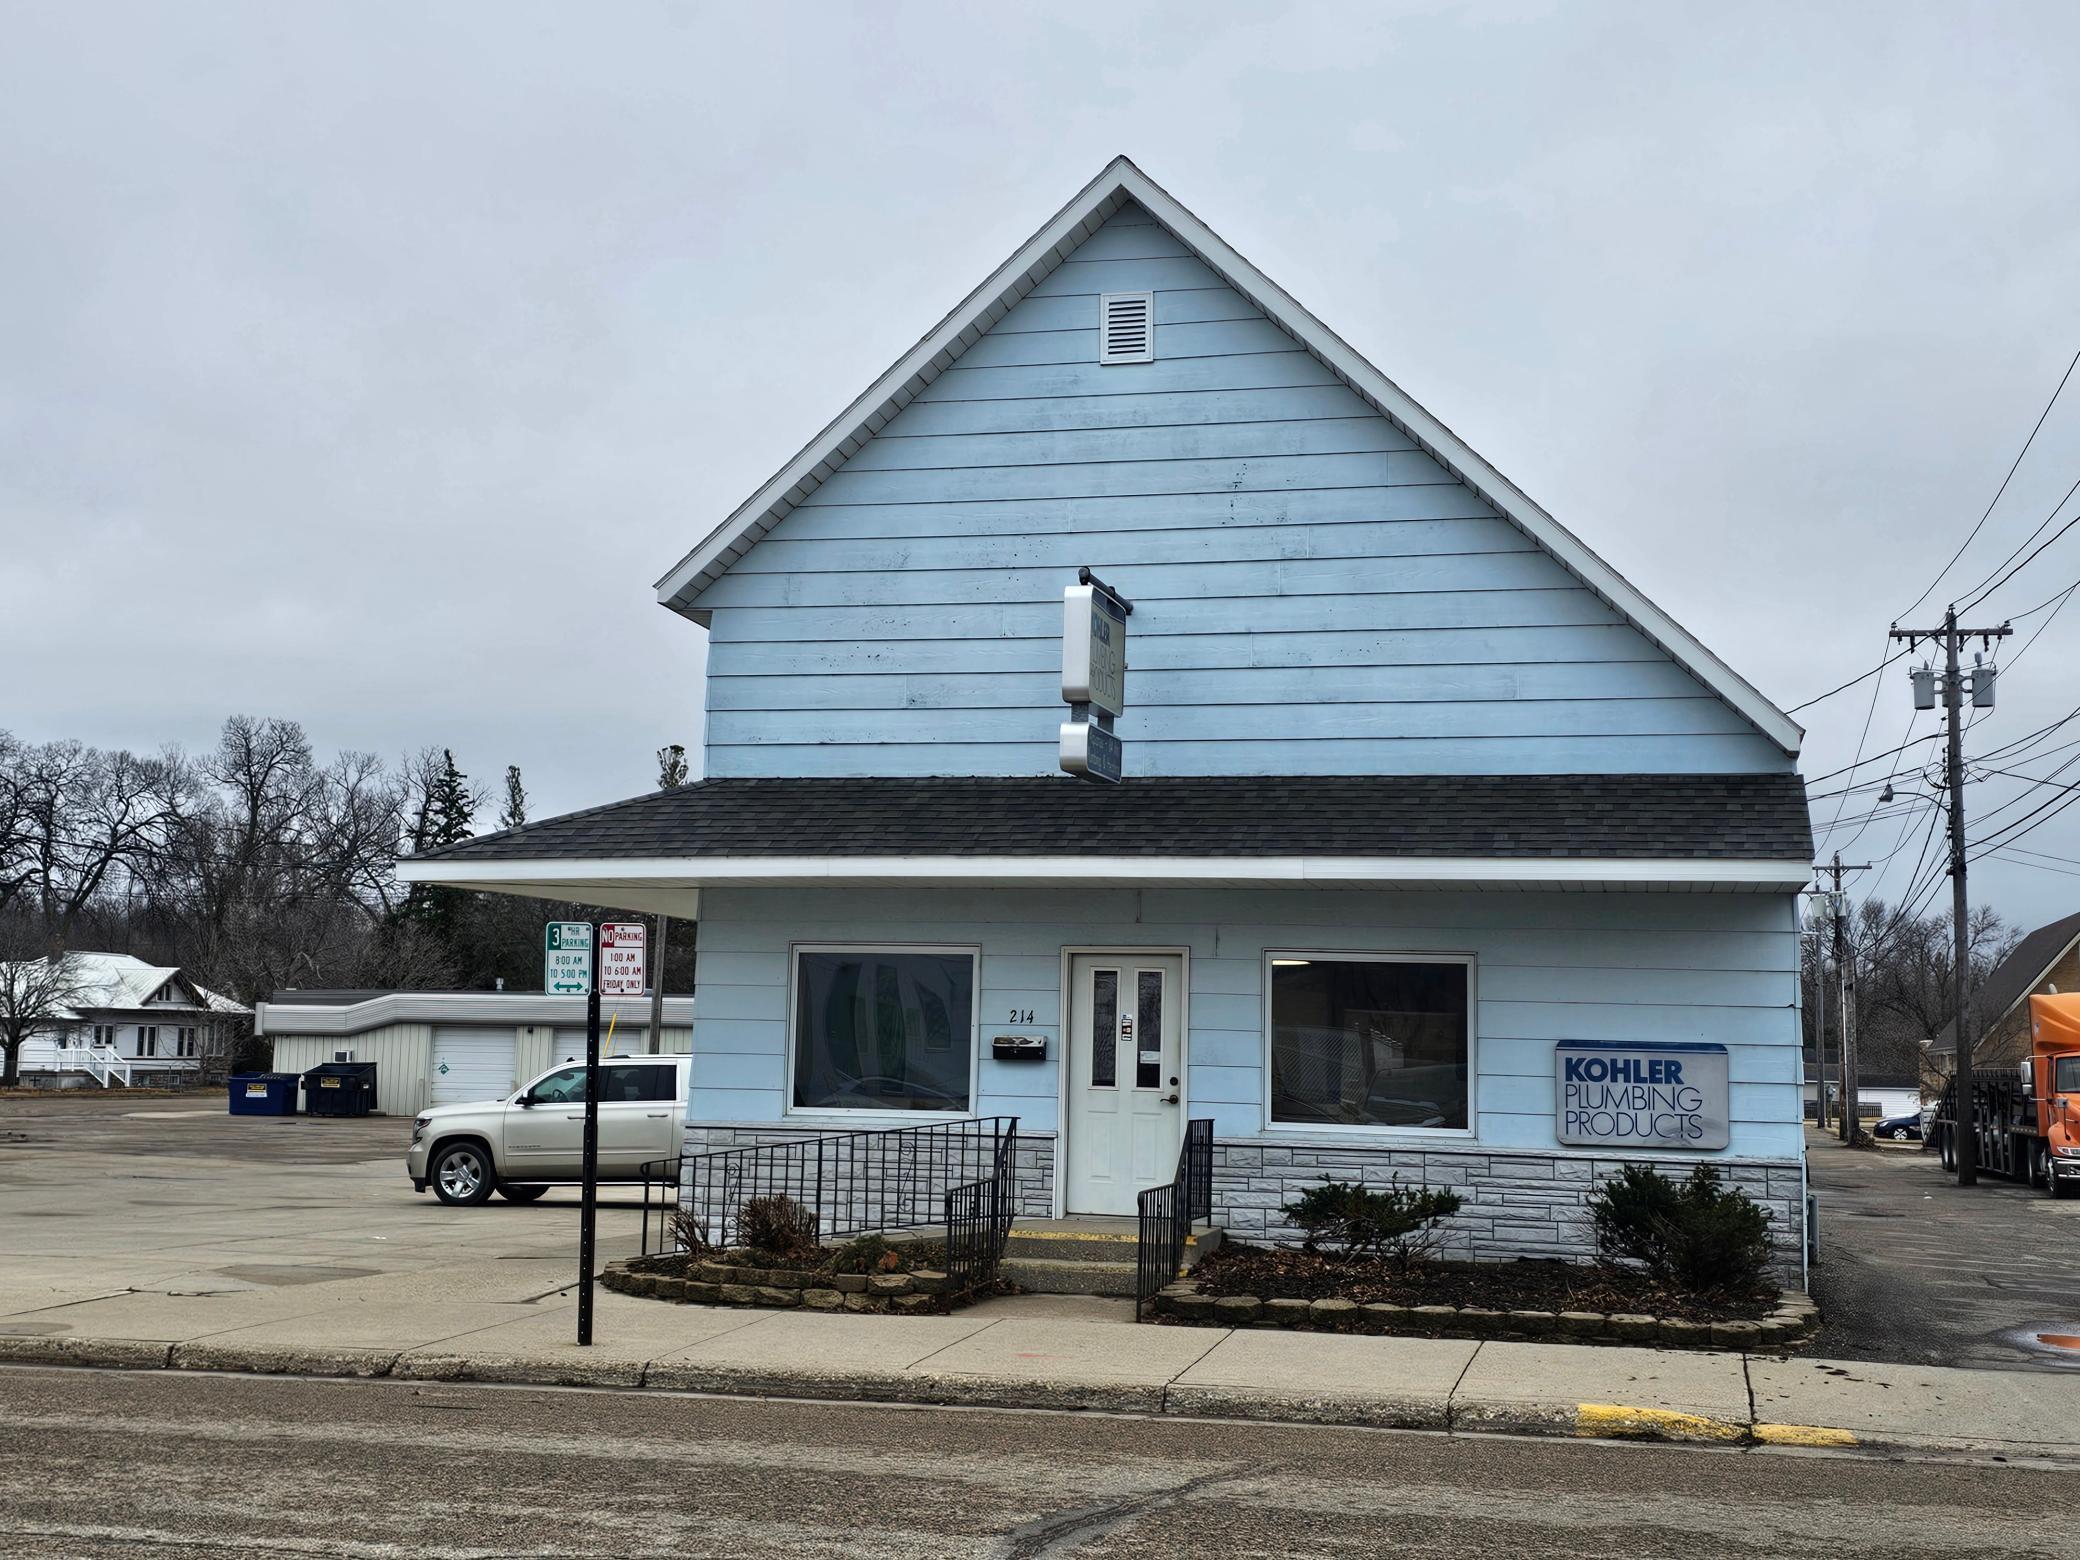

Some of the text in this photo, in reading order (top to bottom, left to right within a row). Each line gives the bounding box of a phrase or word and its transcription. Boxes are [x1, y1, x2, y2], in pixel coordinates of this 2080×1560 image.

[552, 927, 559, 945] 3
[602, 928, 642, 943] NO PARKING
[562, 938, 589, 948] PARKING
[573, 956, 582, 965] AM
[626, 953, 635, 962] AM
[550, 969, 558, 978] TO
[578, 969, 587, 978] PM
[604, 966, 612, 975] TO
[632, 966, 641, 975] AM
[603, 980, 640, 988] FRIDAY ONLY
[1009, 1009, 1034, 1024] 214
[1565, 1057, 1684, 1085] KOHLER
[1565, 1084, 1703, 1112] PLUMBING
[1565, 1110, 1703, 1139] PRODUCTS
